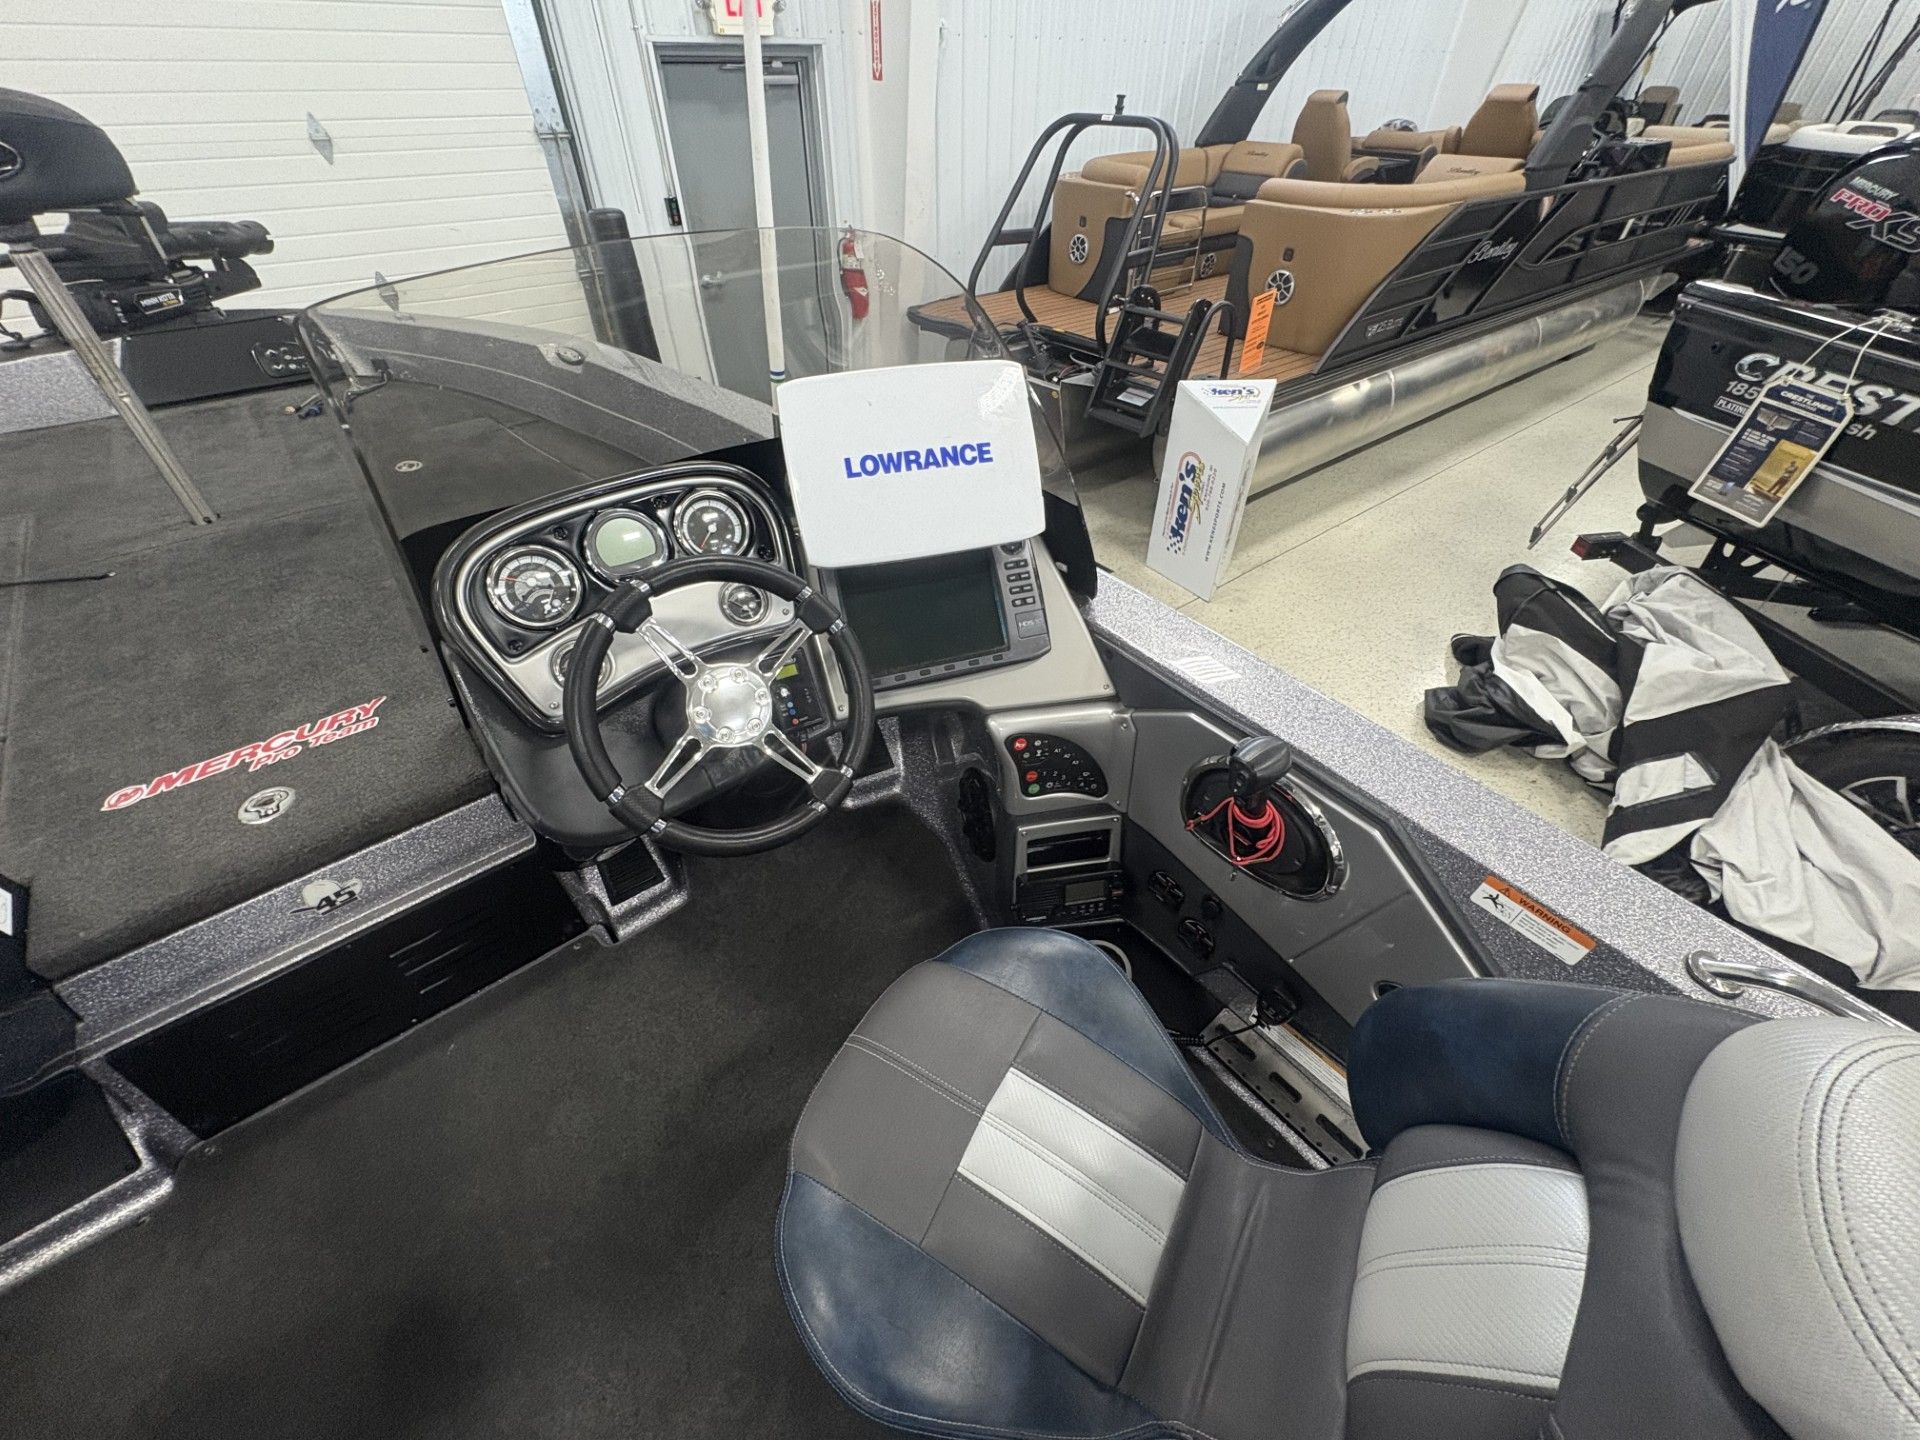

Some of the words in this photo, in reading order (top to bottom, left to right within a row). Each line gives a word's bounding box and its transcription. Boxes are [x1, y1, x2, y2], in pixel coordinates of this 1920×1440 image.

[1829, 187, 1892, 222] PRO
[1850, 176, 1900, 200] MERCURY
[1845, 205, 1920, 253] XS
[1735, 353, 1920, 441] CREST
[1781, 391, 1834, 412] CRESTLINER
[843, 442, 993, 479] LOWRANCE
[144, 695, 387, 799] MERCURY
[1519, 898, 1571, 934] WARNING
